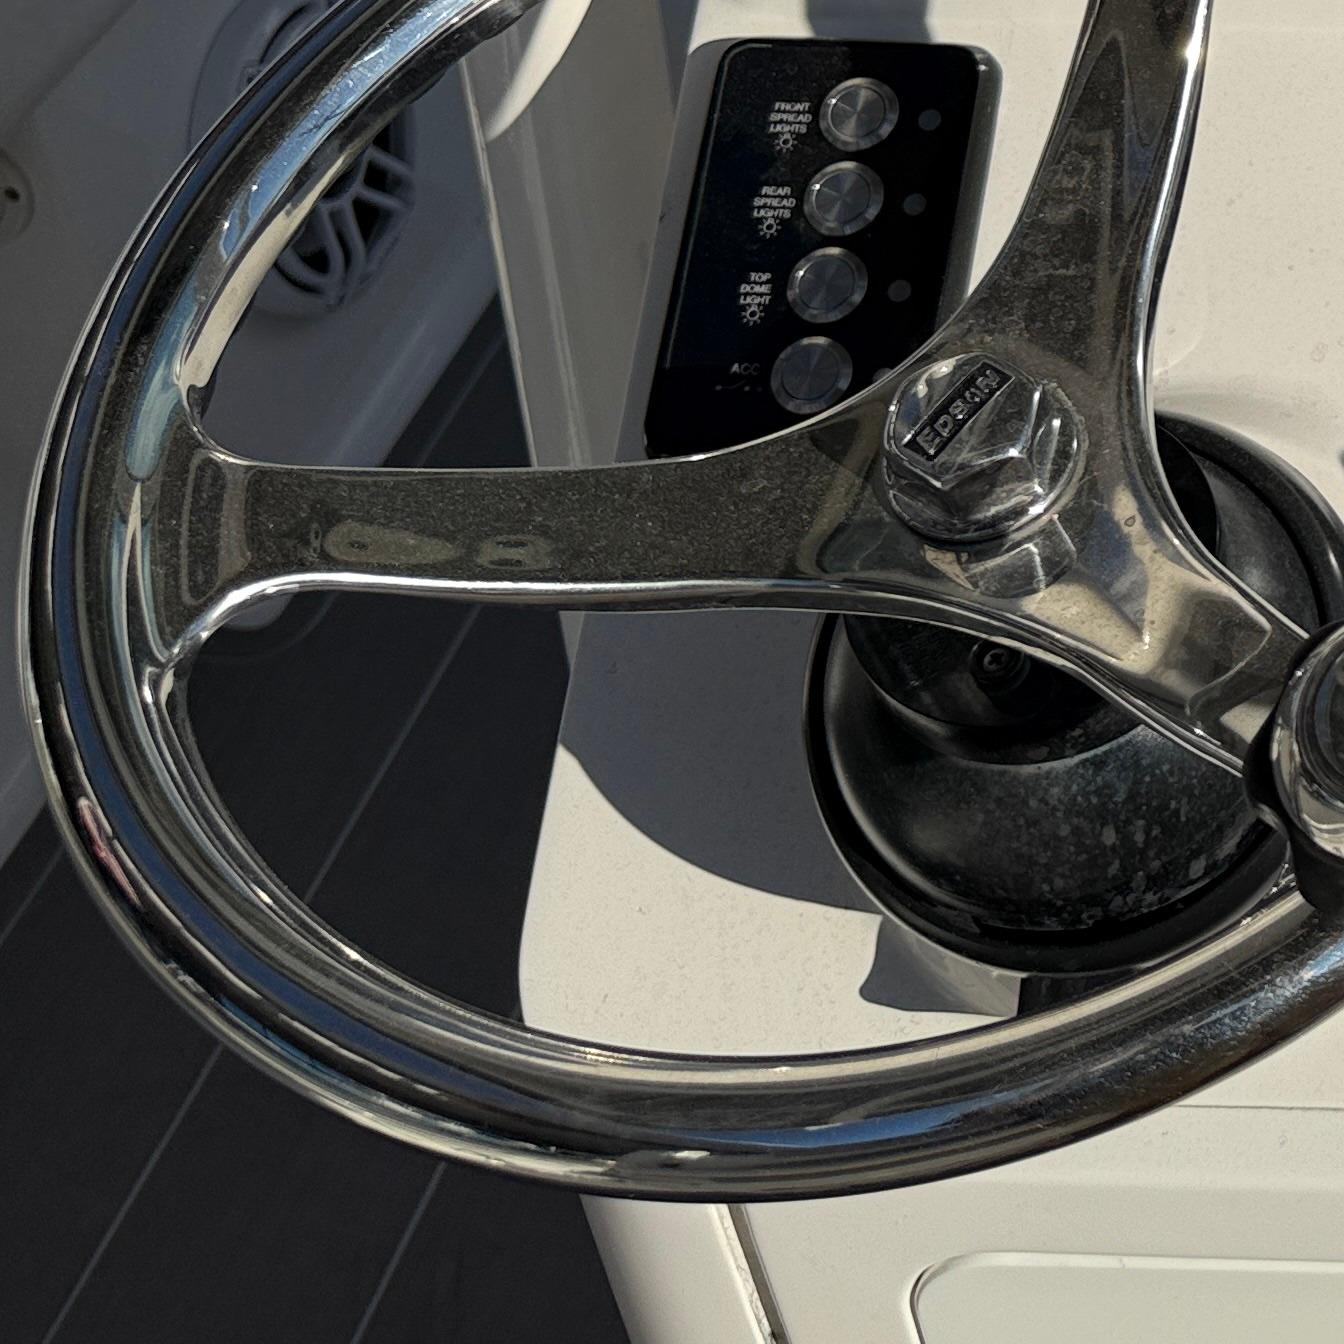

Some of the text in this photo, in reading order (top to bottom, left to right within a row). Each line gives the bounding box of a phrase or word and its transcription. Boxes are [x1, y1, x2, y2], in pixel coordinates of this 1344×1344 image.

[774, 101, 812, 112] FRONT
[768, 112, 813, 123] SPREAD
[768, 123, 808, 135] LIGHTS
[761, 186, 791, 196] REAR
[753, 197, 796, 208] SPREAD
[753, 208, 791, 219] LIGHTS
[748, 272, 772, 283] TOP
[740, 283, 773, 294] DOME
[739, 294, 772, 306] LIGHT
[730, 363, 761, 375] ACC
[916, 369, 1001, 456] EDSON
